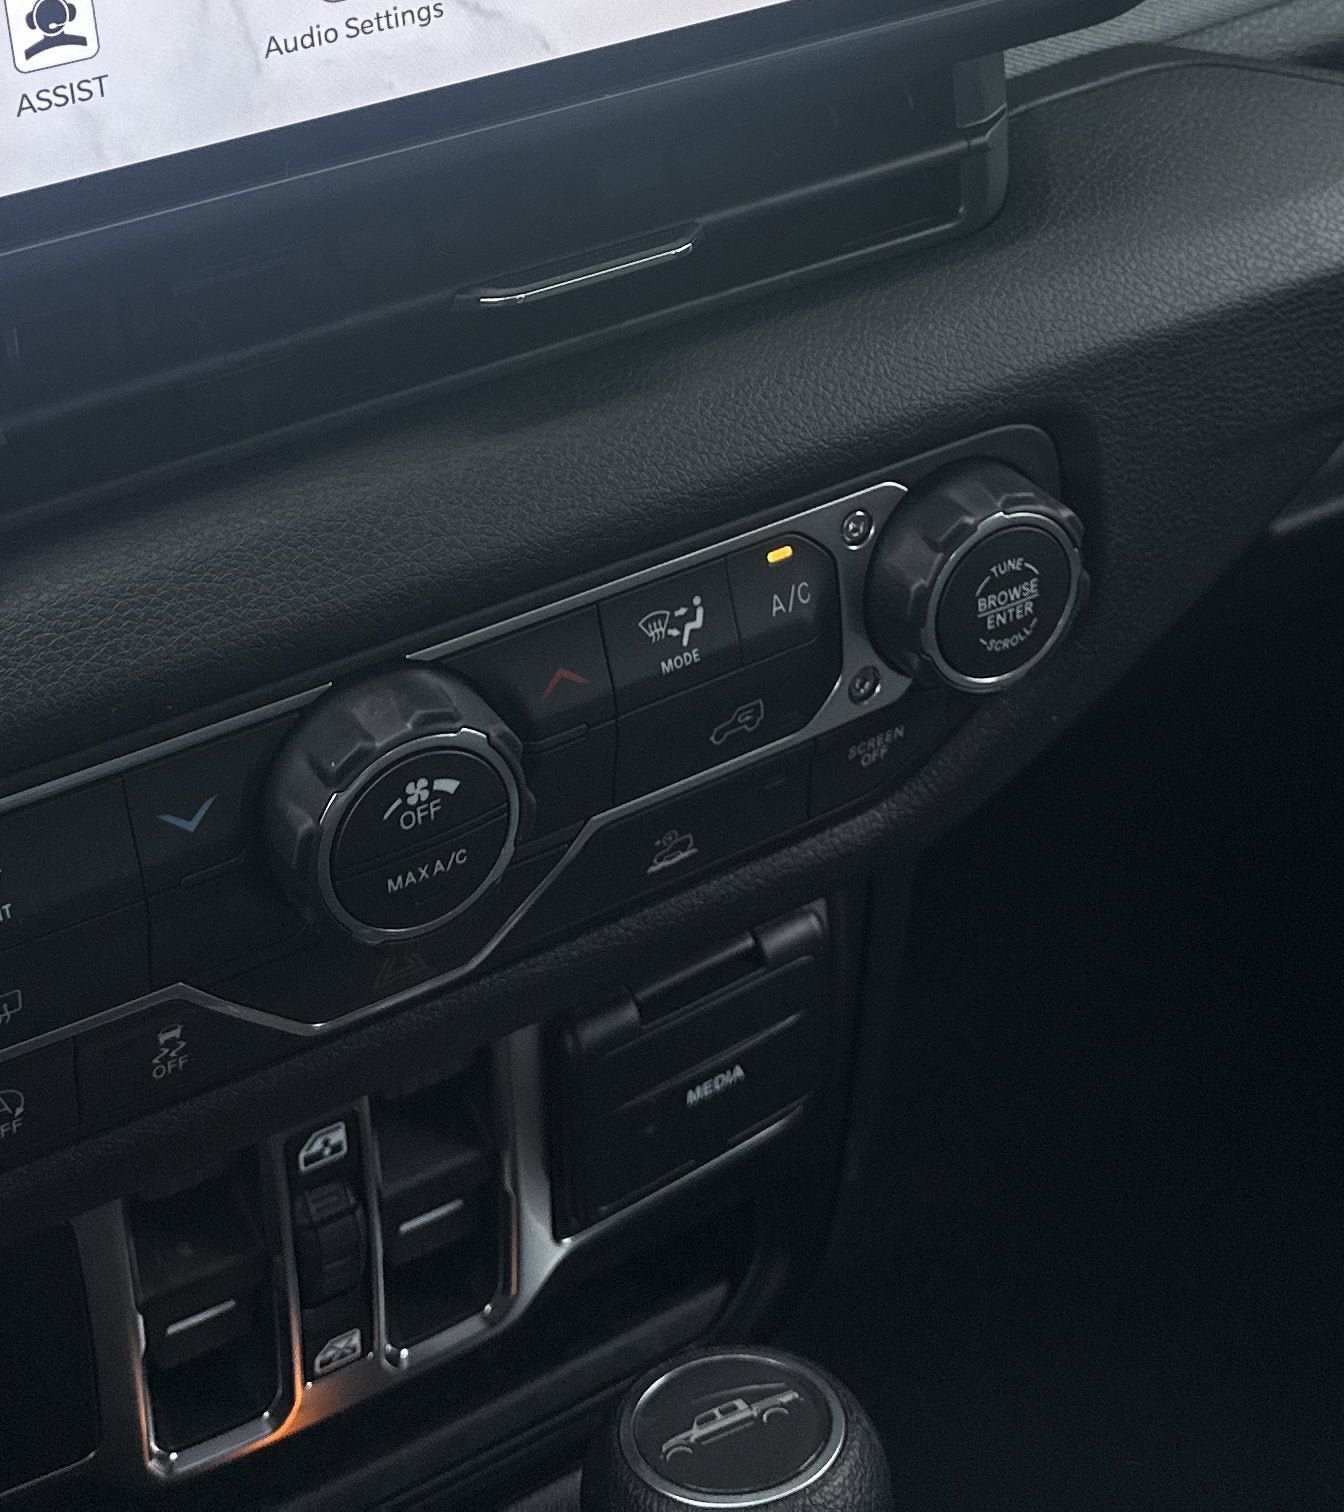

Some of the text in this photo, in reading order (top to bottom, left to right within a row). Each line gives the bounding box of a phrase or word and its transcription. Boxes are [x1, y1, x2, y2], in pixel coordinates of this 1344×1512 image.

[264, 0, 444, 59] Audio Settings
[16, 74, 110, 117] ASSIST
[989, 557, 1024, 578] TUNE
[771, 581, 812, 618] A/C
[978, 578, 1039, 612] BROWSE
[986, 600, 1034, 630] ENTER
[986, 626, 1034, 651] SCROLL
[660, 647, 701, 675] MODE
[847, 724, 905, 760] SCREEN
[860, 744, 889, 767] OFF
[399, 798, 442, 831] OFF
[387, 848, 467, 893] MAX A/C
[152, 1054, 188, 1079] OFF
[686, 1064, 745, 1107] MEDIA
